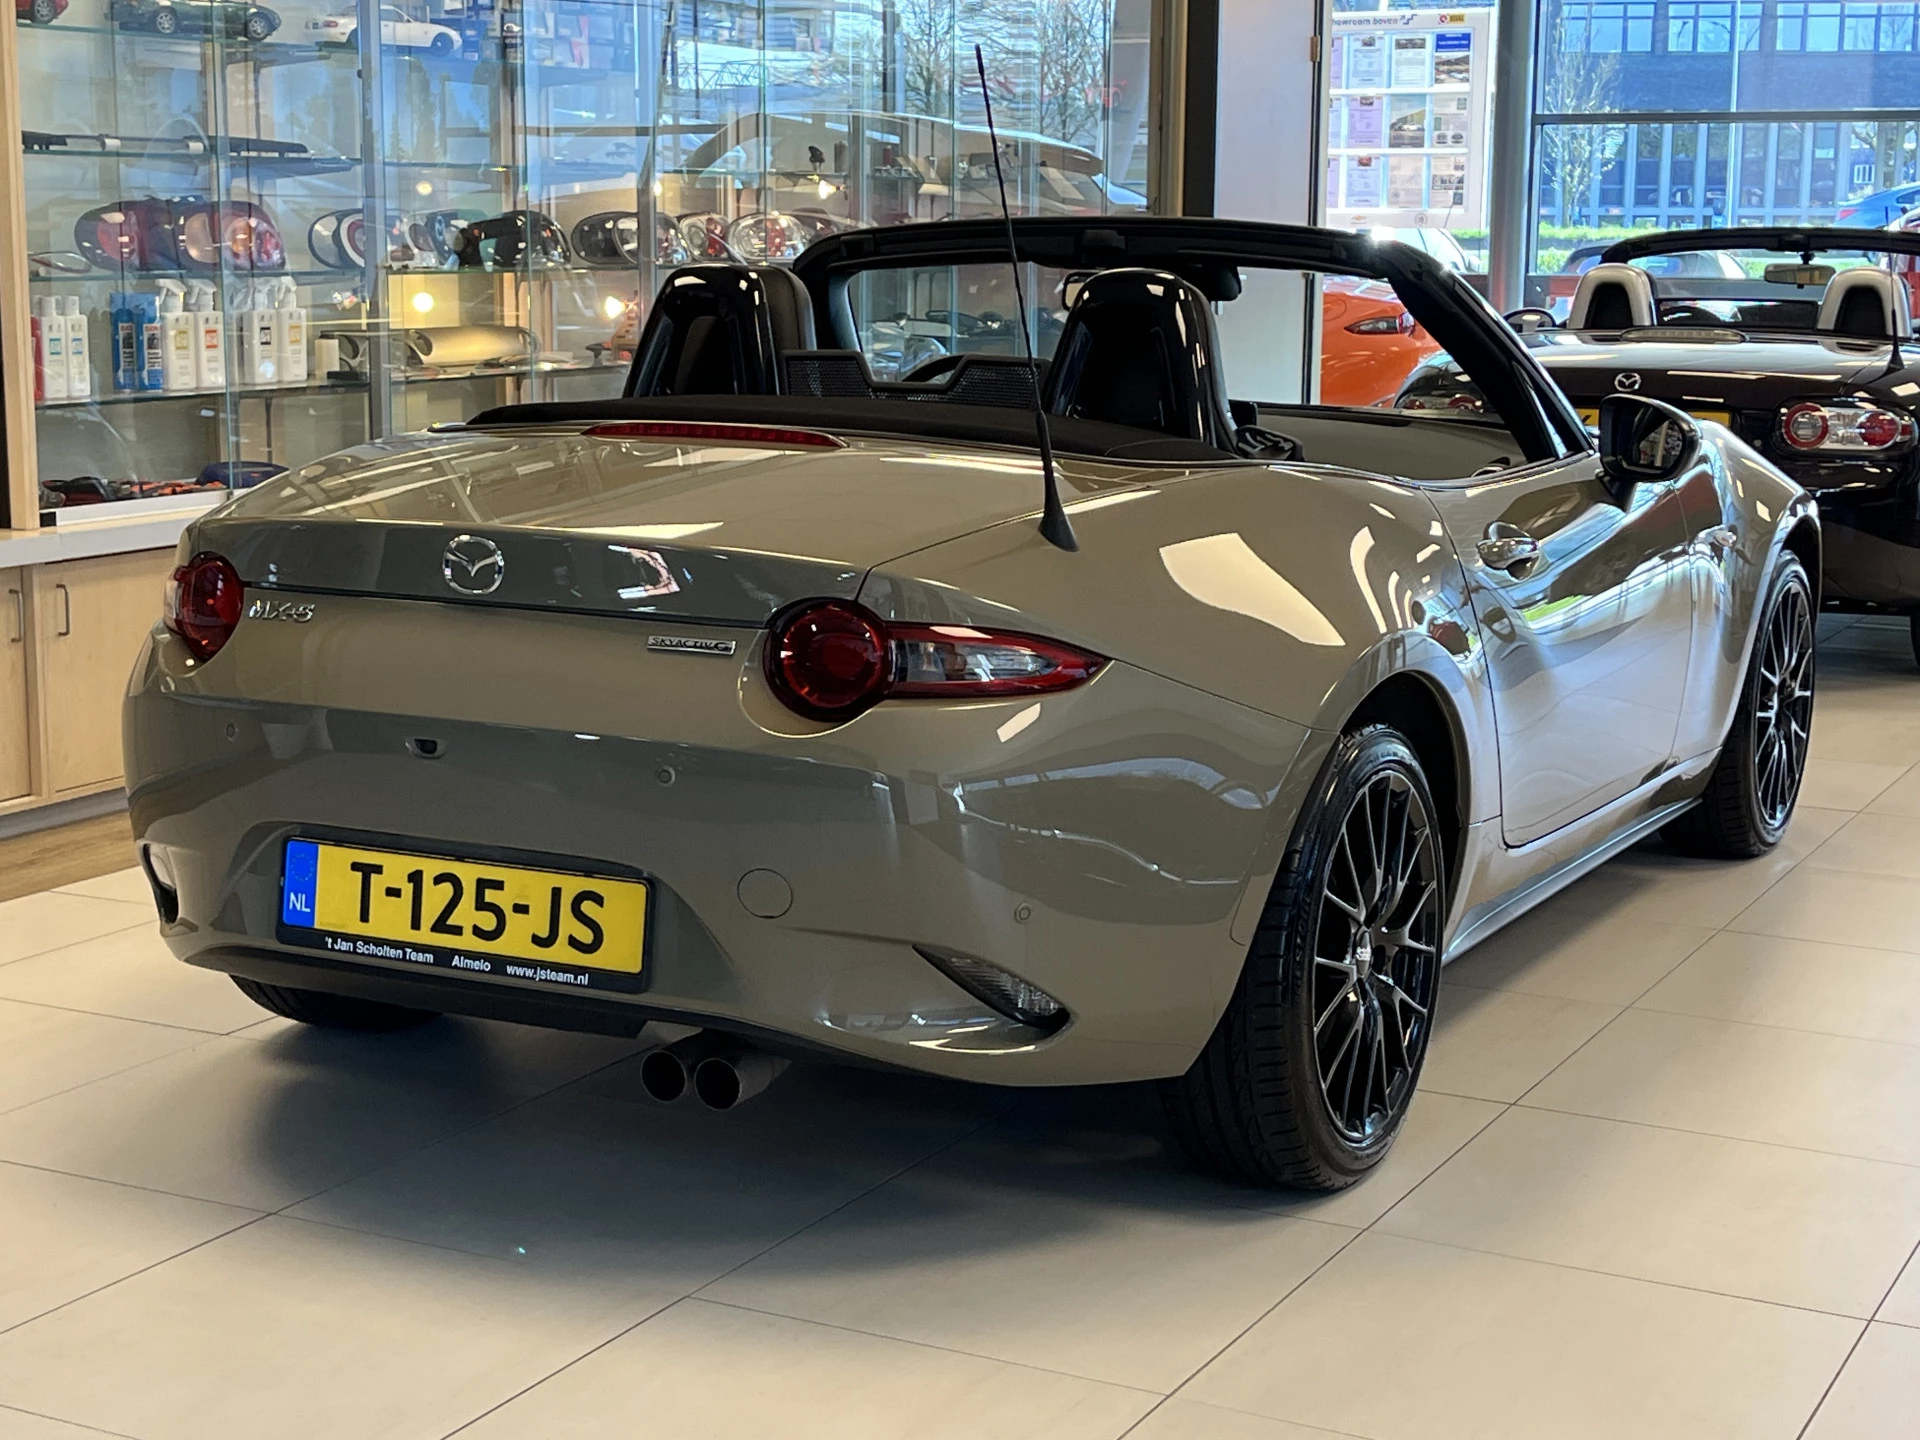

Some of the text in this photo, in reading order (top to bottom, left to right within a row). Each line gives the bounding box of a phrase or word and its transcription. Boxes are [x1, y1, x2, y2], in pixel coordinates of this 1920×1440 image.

[289, 892, 311, 913] NL
[350, 861, 605, 955] T-125-JS
[334, 938, 353, 952] Jan
[356, 941, 403, 959] Scholten
[405, 948, 434, 964] Team
[452, 954, 491, 972] Almelo
[506, 964, 589, 986] www.jsteam.nl
